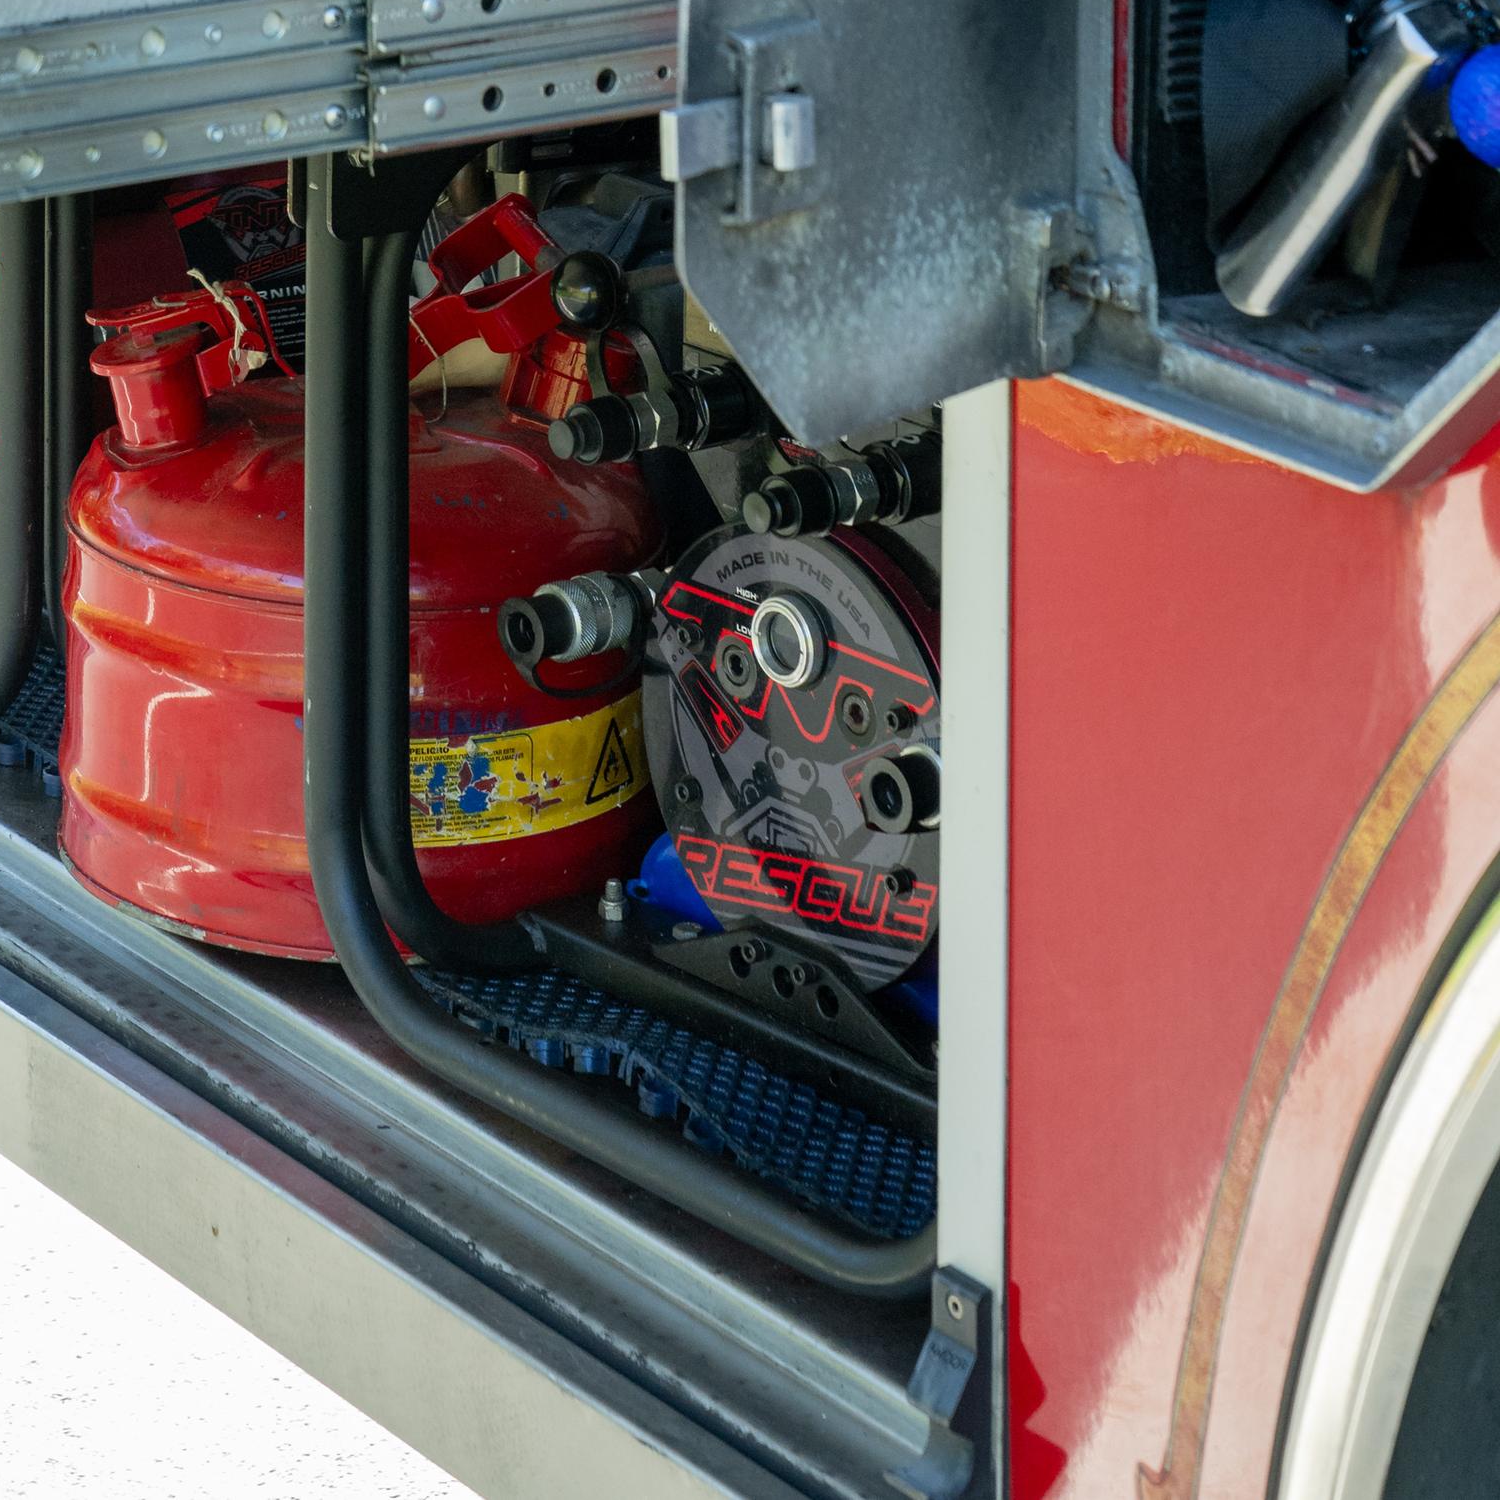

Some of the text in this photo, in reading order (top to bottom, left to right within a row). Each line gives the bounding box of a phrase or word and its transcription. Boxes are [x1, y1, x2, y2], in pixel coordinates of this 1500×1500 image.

[716, 551, 871, 641] MADE IN THE USA
[736, 586, 759, 601] HIGH
[675, 834, 939, 942] RESCUE
